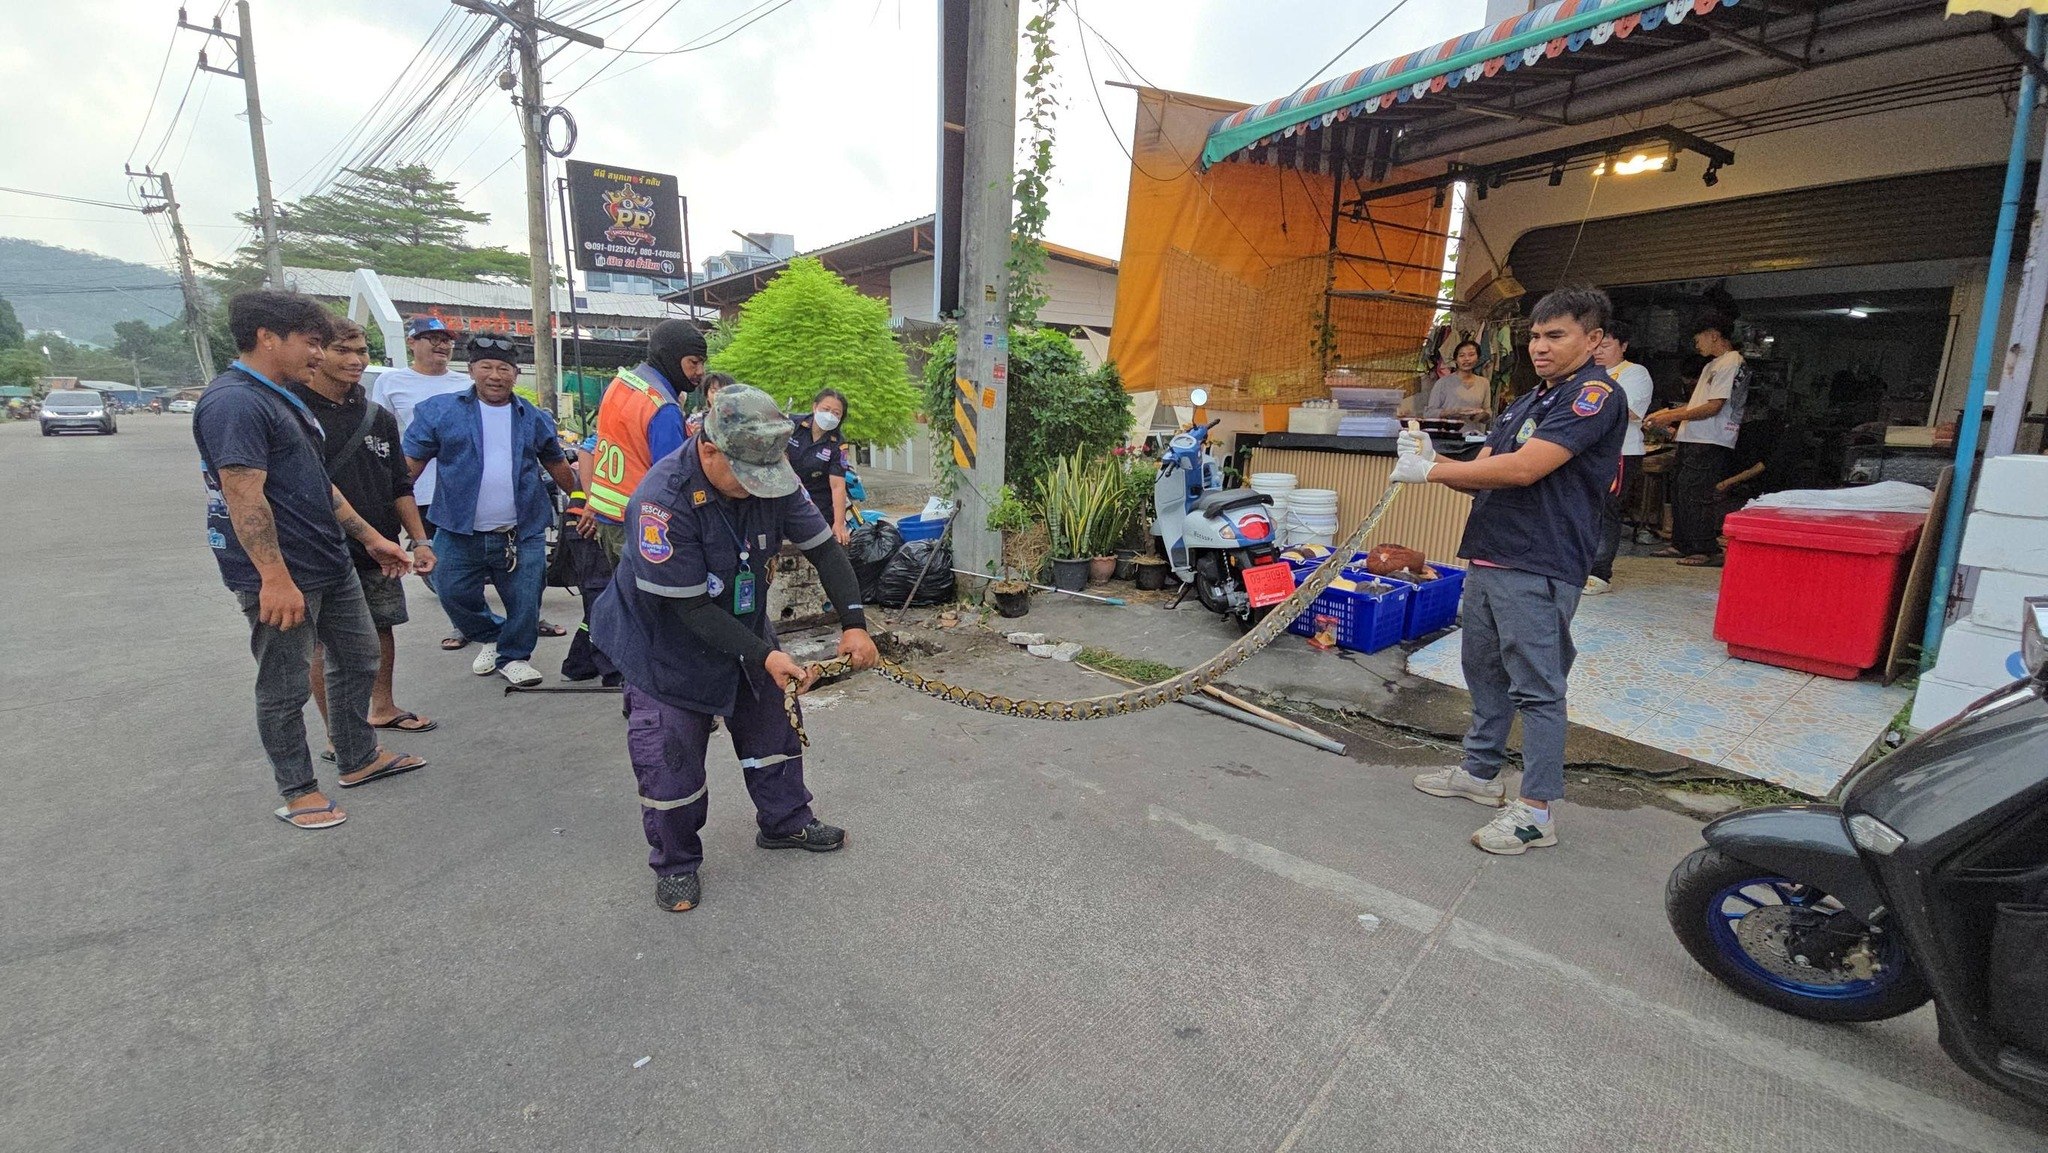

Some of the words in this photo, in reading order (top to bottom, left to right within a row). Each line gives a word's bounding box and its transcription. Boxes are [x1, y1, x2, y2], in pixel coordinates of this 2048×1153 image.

[614, 209, 650, 229] PP
[606, 255, 624, 267] เปิด
[624, 258, 635, 268] 24
[595, 439, 625, 484] 20
[641, 504, 670, 520] RESCUE
